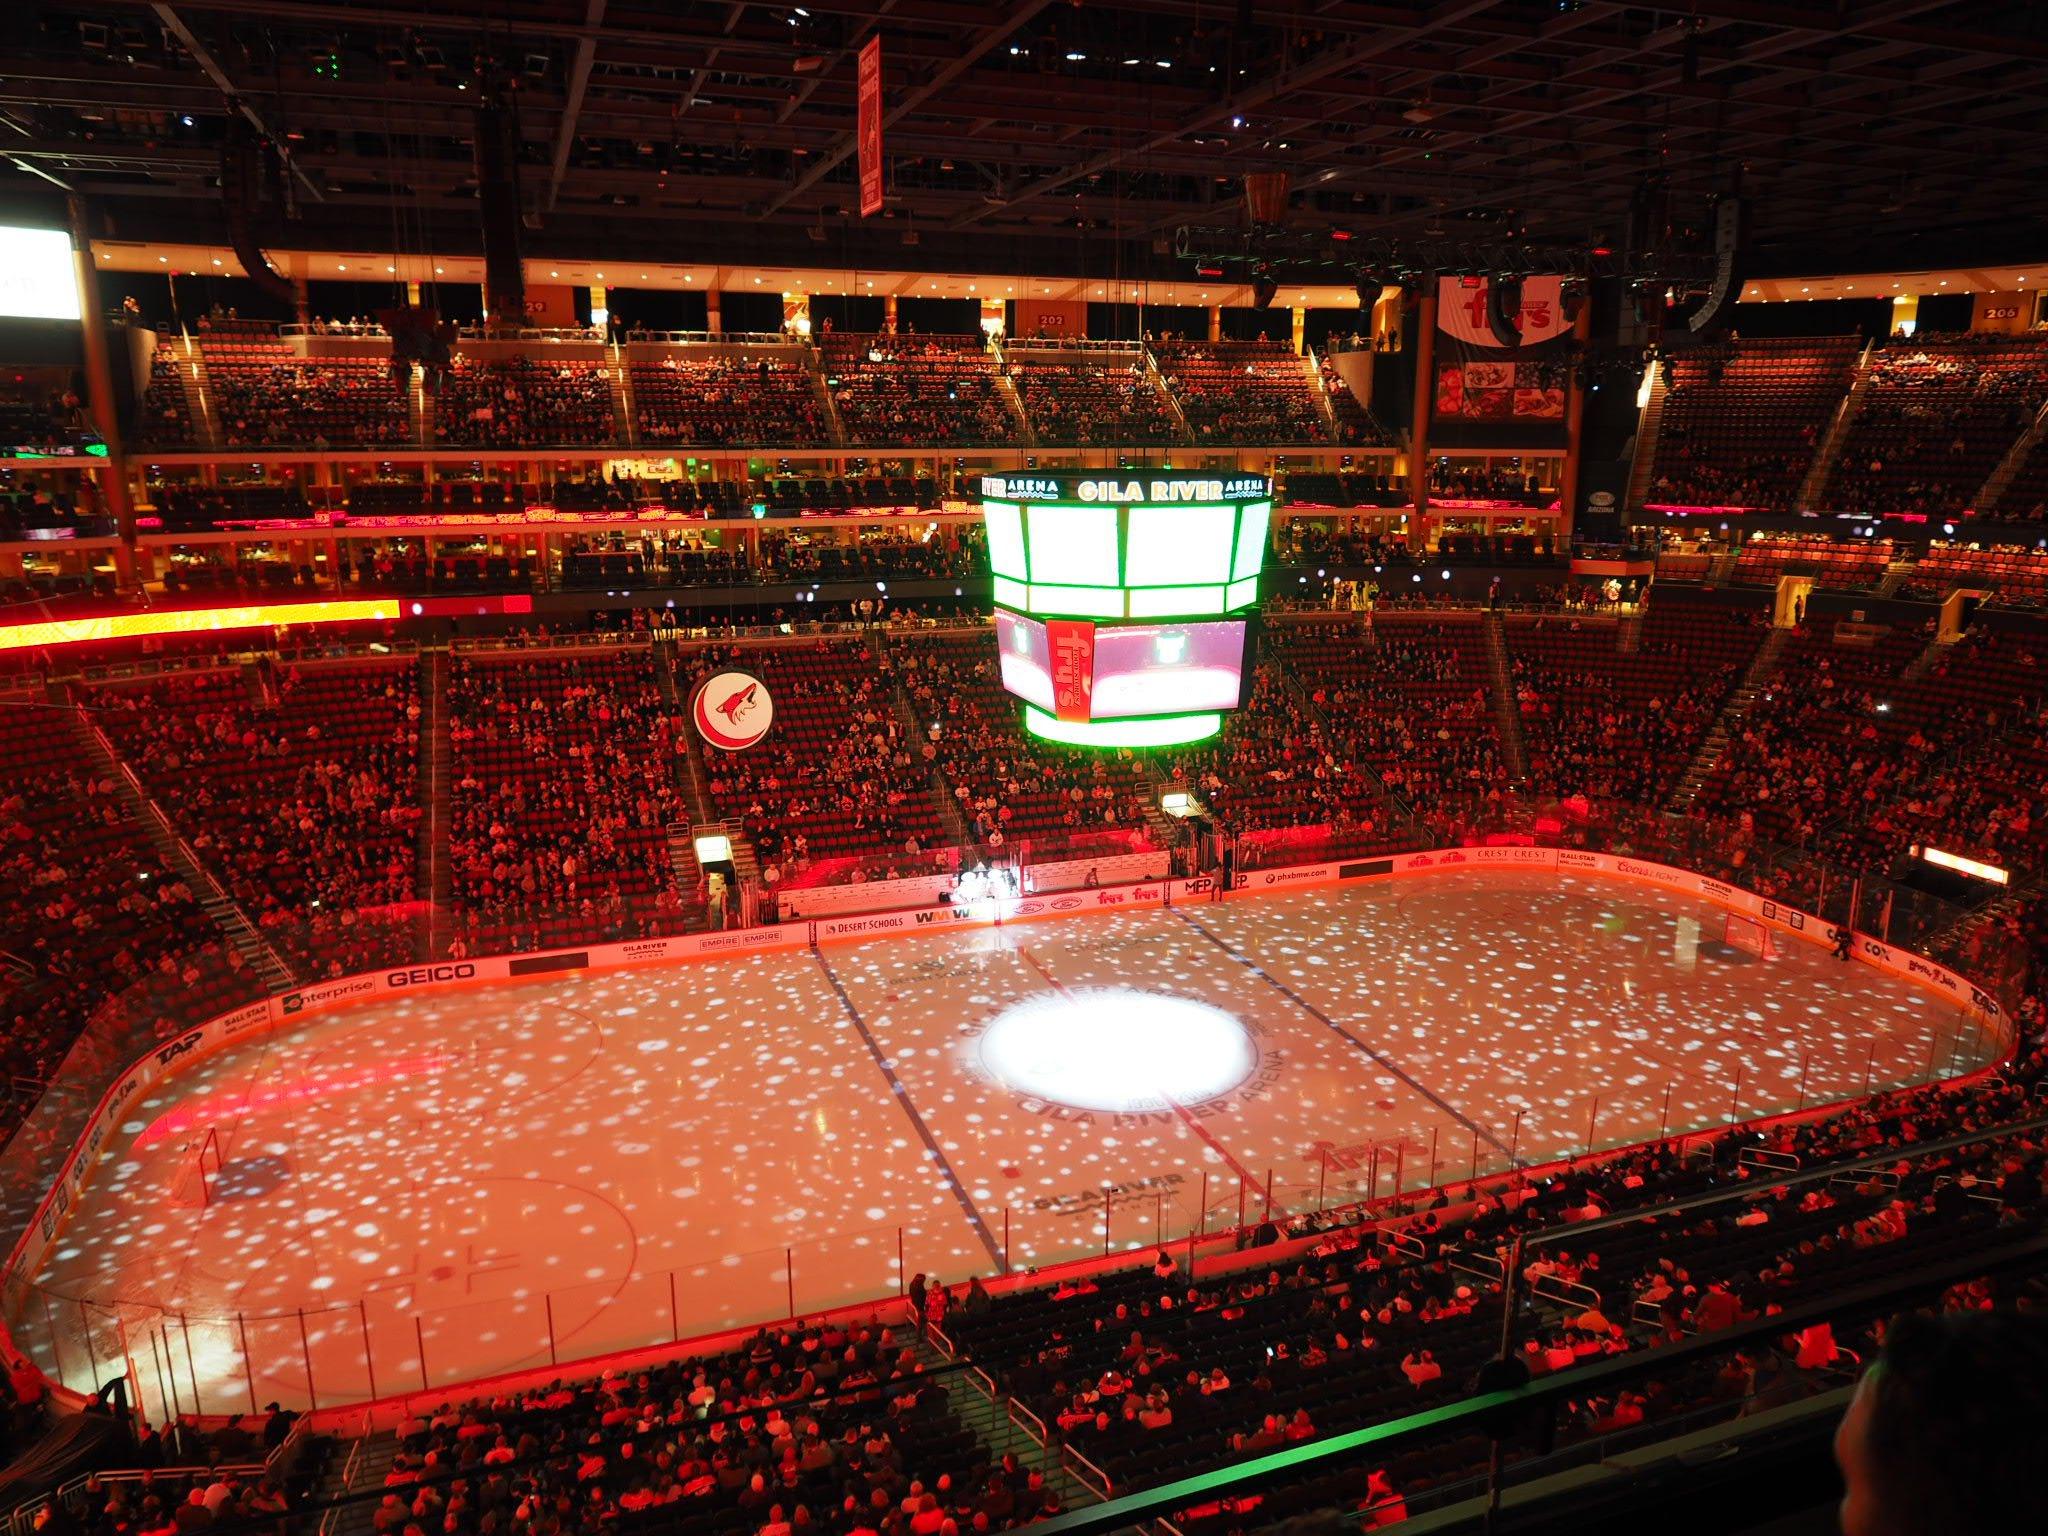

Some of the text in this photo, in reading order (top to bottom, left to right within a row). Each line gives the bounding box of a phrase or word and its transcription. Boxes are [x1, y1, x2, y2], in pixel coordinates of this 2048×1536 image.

[526, 302, 543, 312] 29
[1987, 309, 2016, 318] 206
[1041, 315, 1063, 325] 202
[981, 476, 1058, 498] IVER ARENA
[1078, 480, 1263, 501] GILA RIVER ARENA
[1478, 850, 1508, 858] CREST
[1514, 850, 1546, 858] CREST
[1277, 869, 1327, 882] phxbmw.com
[1185, 878, 1211, 892] MFP
[915, 910, 950, 923] WM
[838, 922, 867, 933] DESERT
[868, 917, 904, 929] SCHOOLS
[701, 937, 738, 948] EMPIRE
[744, 932, 780, 943] EMPIRE
[387, 963, 475, 988] GEICO
[156, 1031, 203, 1066] TAP
[1017, 1099, 1096, 1126] GILA
[1239, 1050, 1287, 1105] ARENA
